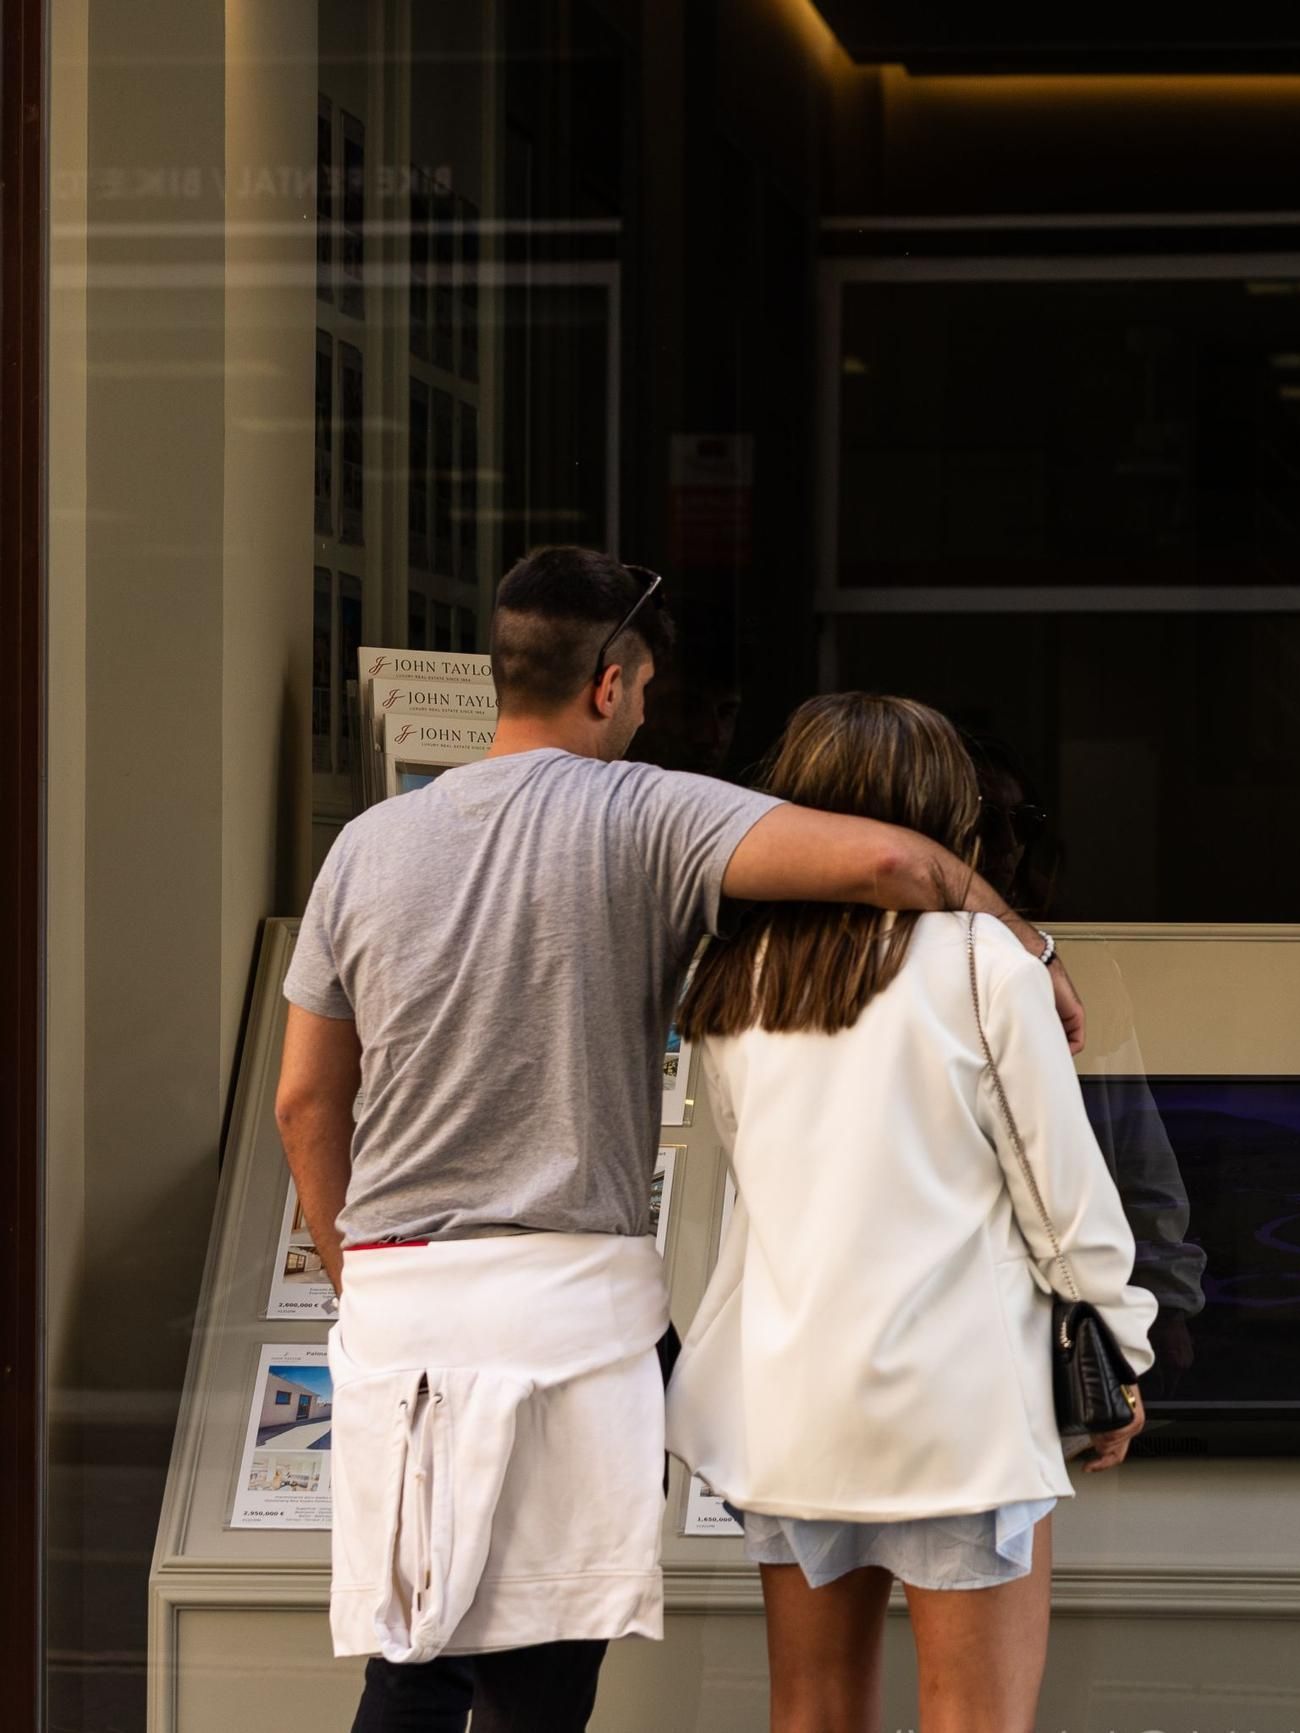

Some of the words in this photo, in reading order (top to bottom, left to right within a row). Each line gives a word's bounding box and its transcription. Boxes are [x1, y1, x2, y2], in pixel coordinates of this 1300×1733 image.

[395, 658, 436, 673] JOHN
[441, 661, 492, 677] TAYLO
[408, 691, 450, 705] JOHN
[456, 694, 498, 708] TAYL
[420, 727, 462, 741] JOHN
[466, 730, 496, 744] TAY
